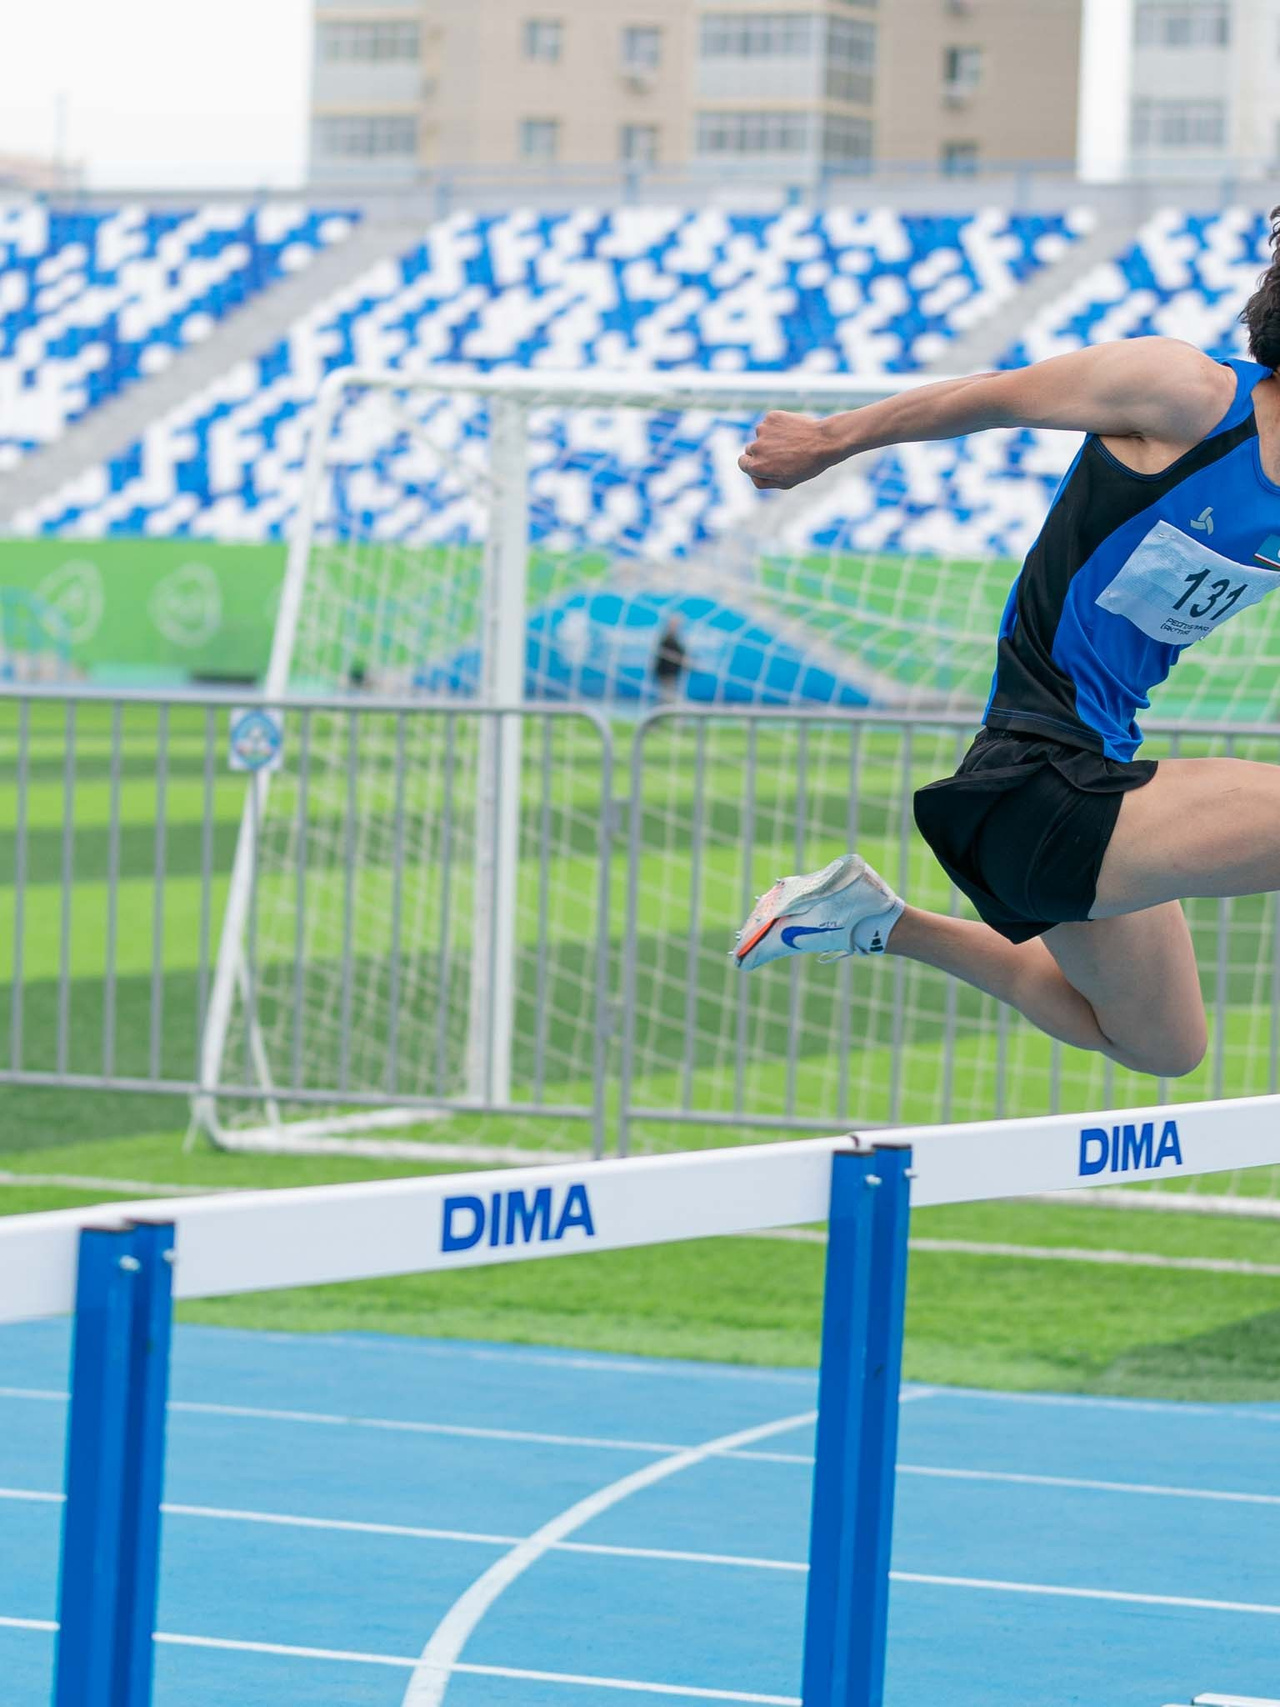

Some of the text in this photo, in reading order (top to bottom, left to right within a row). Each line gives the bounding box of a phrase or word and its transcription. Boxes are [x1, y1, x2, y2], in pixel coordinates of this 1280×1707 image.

[1172, 568, 1249, 621] 131
[1078, 1119, 1184, 1177] DIMA
[439, 1182, 596, 1255] DIMA
